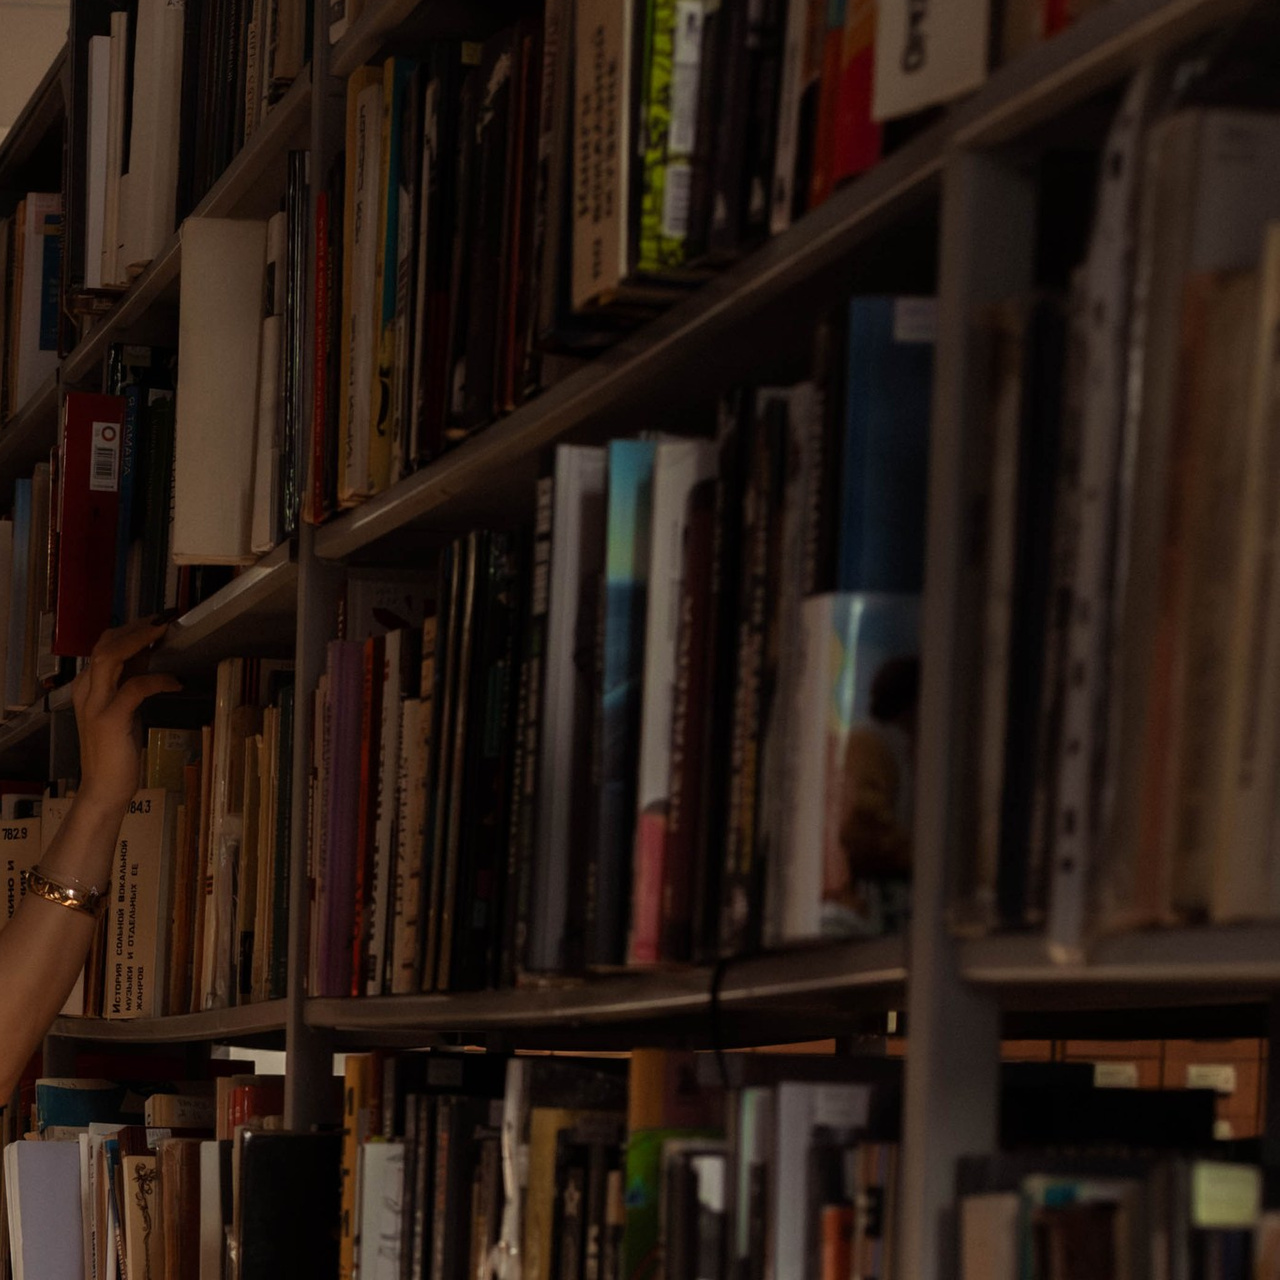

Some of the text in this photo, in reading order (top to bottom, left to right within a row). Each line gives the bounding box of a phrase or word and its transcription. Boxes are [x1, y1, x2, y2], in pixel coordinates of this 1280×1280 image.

[117, 839, 128, 903] ВОКАЛЬНОЙ
[114, 907, 125, 956] СОЛЬНОЙ
[127, 883, 138, 947] ОТДЕЛЬНЫХ
[126, 951, 134, 960] И
[125, 965, 134, 1012] МУЗЫКИ
[135, 966, 145, 1012] ЖАНРОВ
